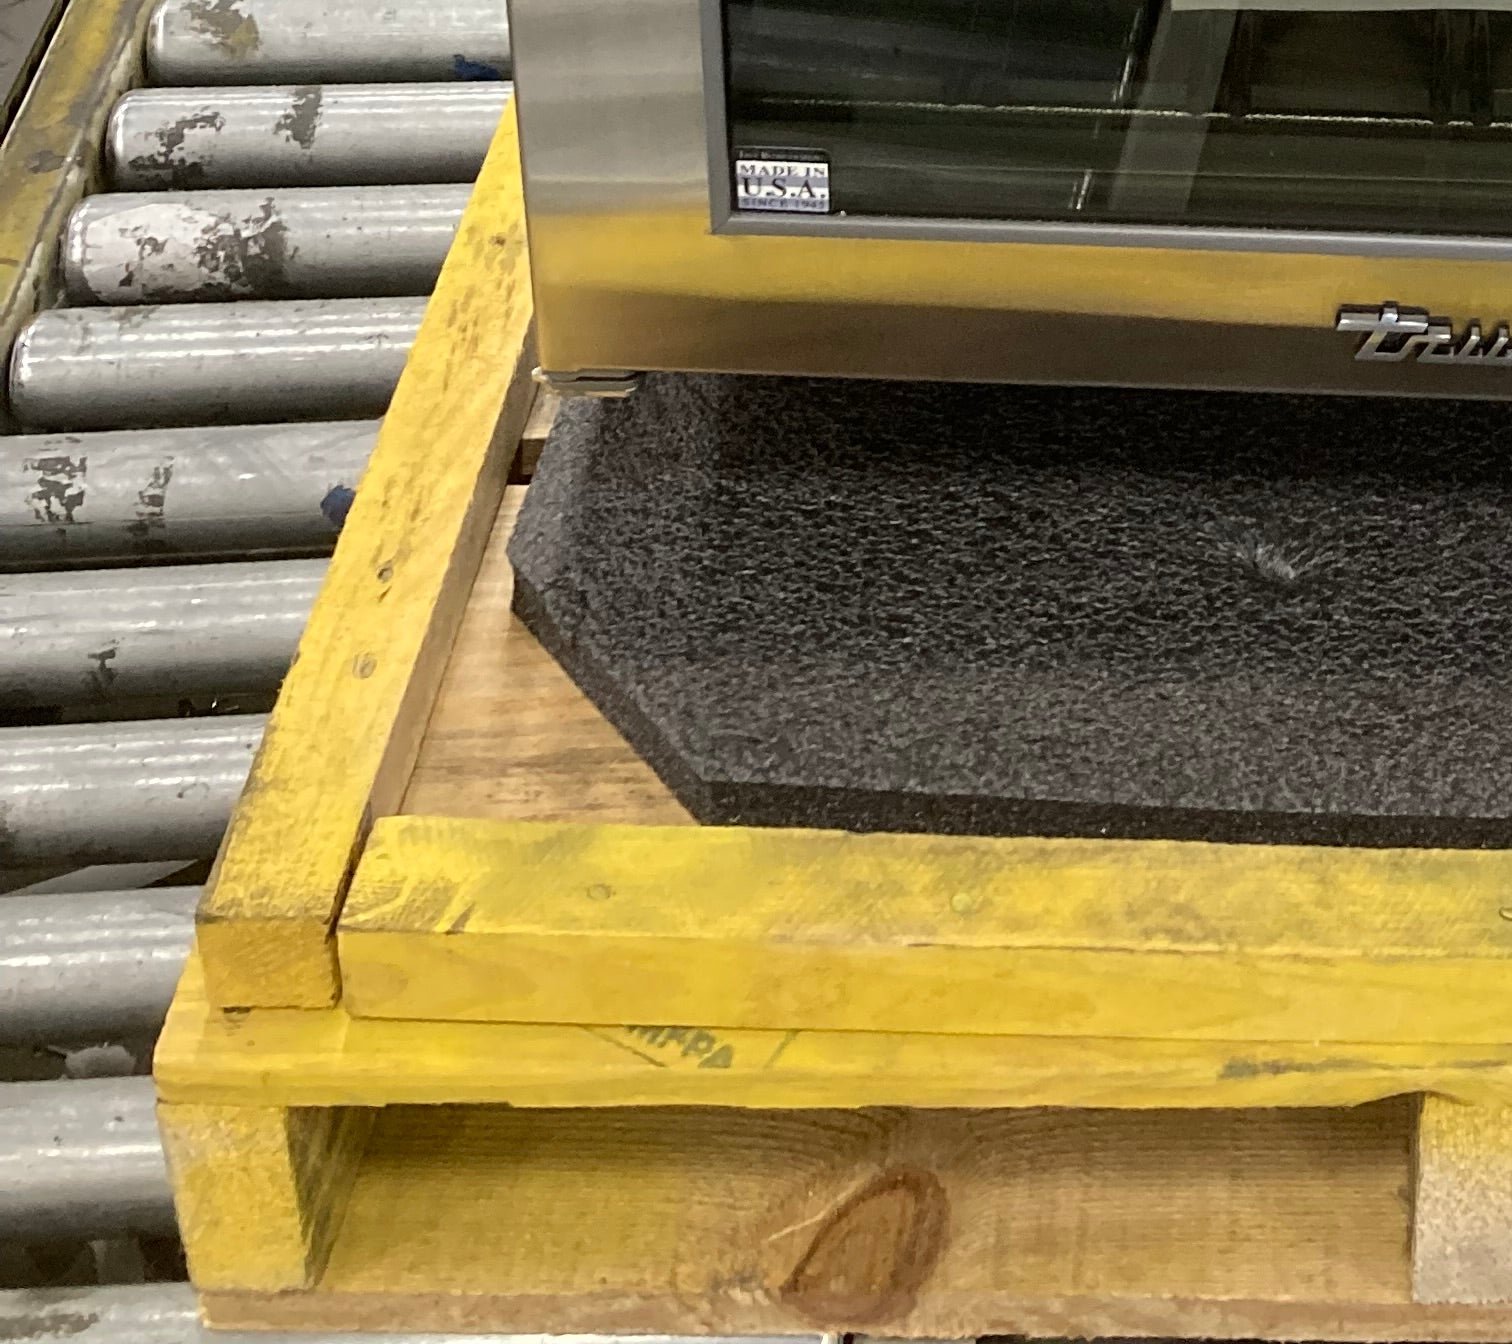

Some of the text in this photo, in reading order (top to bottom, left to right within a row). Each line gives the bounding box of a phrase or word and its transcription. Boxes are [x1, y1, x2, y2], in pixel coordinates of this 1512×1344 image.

[740, 164, 826, 178] MADE IN
[742, 177, 826, 199] U.S.A.
